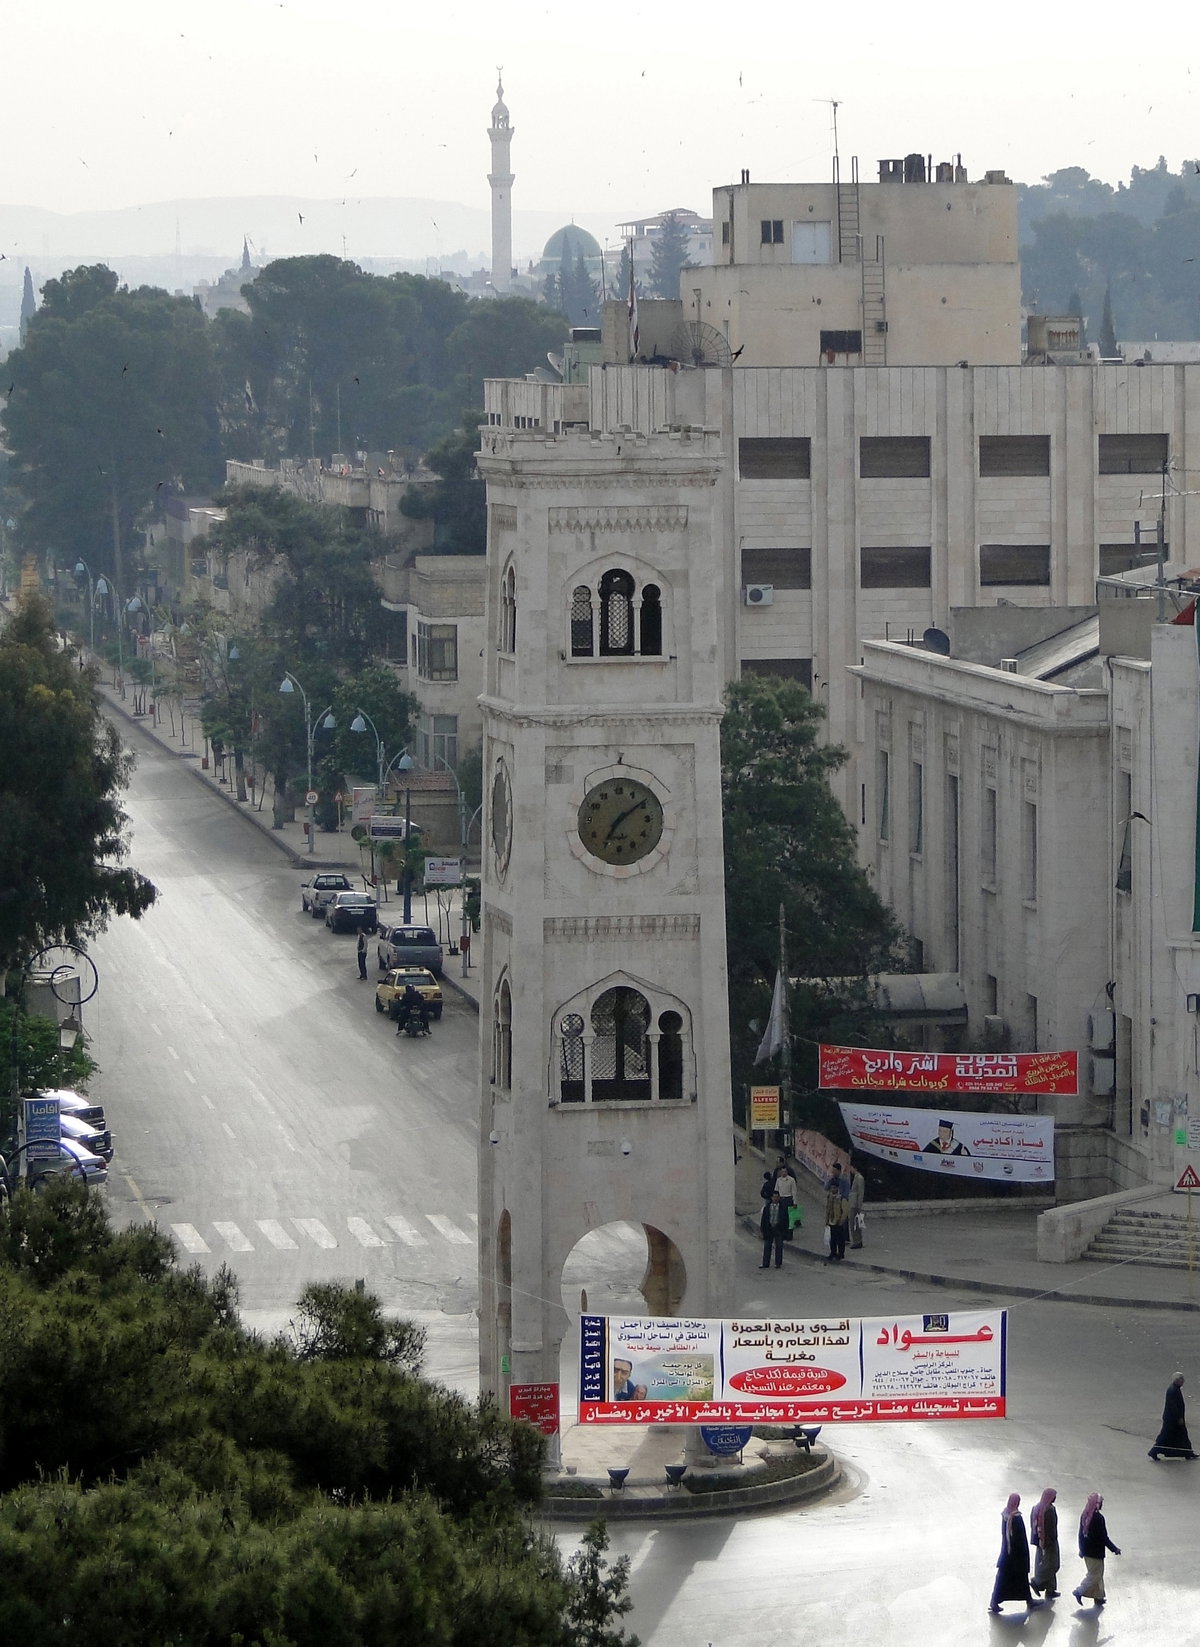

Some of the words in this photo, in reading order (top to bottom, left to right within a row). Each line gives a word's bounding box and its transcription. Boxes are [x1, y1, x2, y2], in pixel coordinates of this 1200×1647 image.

[956, 1064, 1018, 1080] المدينة
[851, 1072, 884, 1088] مجانية
[887, 1074, 906, 1089] شراء
[909, 1075, 948, 1090] كوبونات
[1016, 1138, 1044, 1148] فساد
[620, 1320, 642, 1330] أجمل
[644, 1321, 654, 1330] إلى
[656, 1322, 682, 1330] الصيف
[684, 1322, 706, 1330] رحلات
[732, 1322, 771, 1333] العمرة
[774, 1322, 805, 1333] برامج
[810, 1320, 850, 1333] أقوى
[584, 1330, 600, 1338] الصدق
[618, 1332, 646, 1340] السوري
[648, 1332, 672, 1340] الساحل
[675, 1332, 684, 1342] في
[686, 1332, 710, 1341] المناطق
[876, 1322, 994, 1350] عواد
[732, 1334, 774, 1348] بأسعار
[786, 1336, 820, 1348] العام
[822, 1336, 850, 1346] لهذا
[646, 1344, 661, 1352] ضيعة
[666, 1344, 690, 1352] الطنافس
[584, 1351, 600, 1359] التي
[766, 1350, 816, 1362] مغرية
[912, 1350, 934, 1360] والسفر
[936, 1350, 960, 1358] للسياحة
[746, 1370, 764, 1382] حاج
[766, 1368, 782, 1379] لكل
[782, 1369, 806, 1381] قيمة
[806, 1368, 828, 1378] هدية
[874, 1370, 891, 1378] الدين
[740, 1382, 777, 1392] التسجيل
[778, 1384, 794, 1392] عند
[796, 1383, 824, 1392] معتمر
[832, 1402, 873, 1418] تربح
[877, 1401, 908, 1414] معنا
[912, 1400, 960, 1415] تسجيلك
[963, 1398, 997, 1412] عند
[586, 1404, 632, 1421] رمضان
[636, 1406, 650, 1420] من
[653, 1403, 689, 1422] الأخير
[692, 1403, 732, 1420] بالعشر
[735, 1404, 784, 1420] مجانية
[788, 1404, 828, 1418] عمرة
